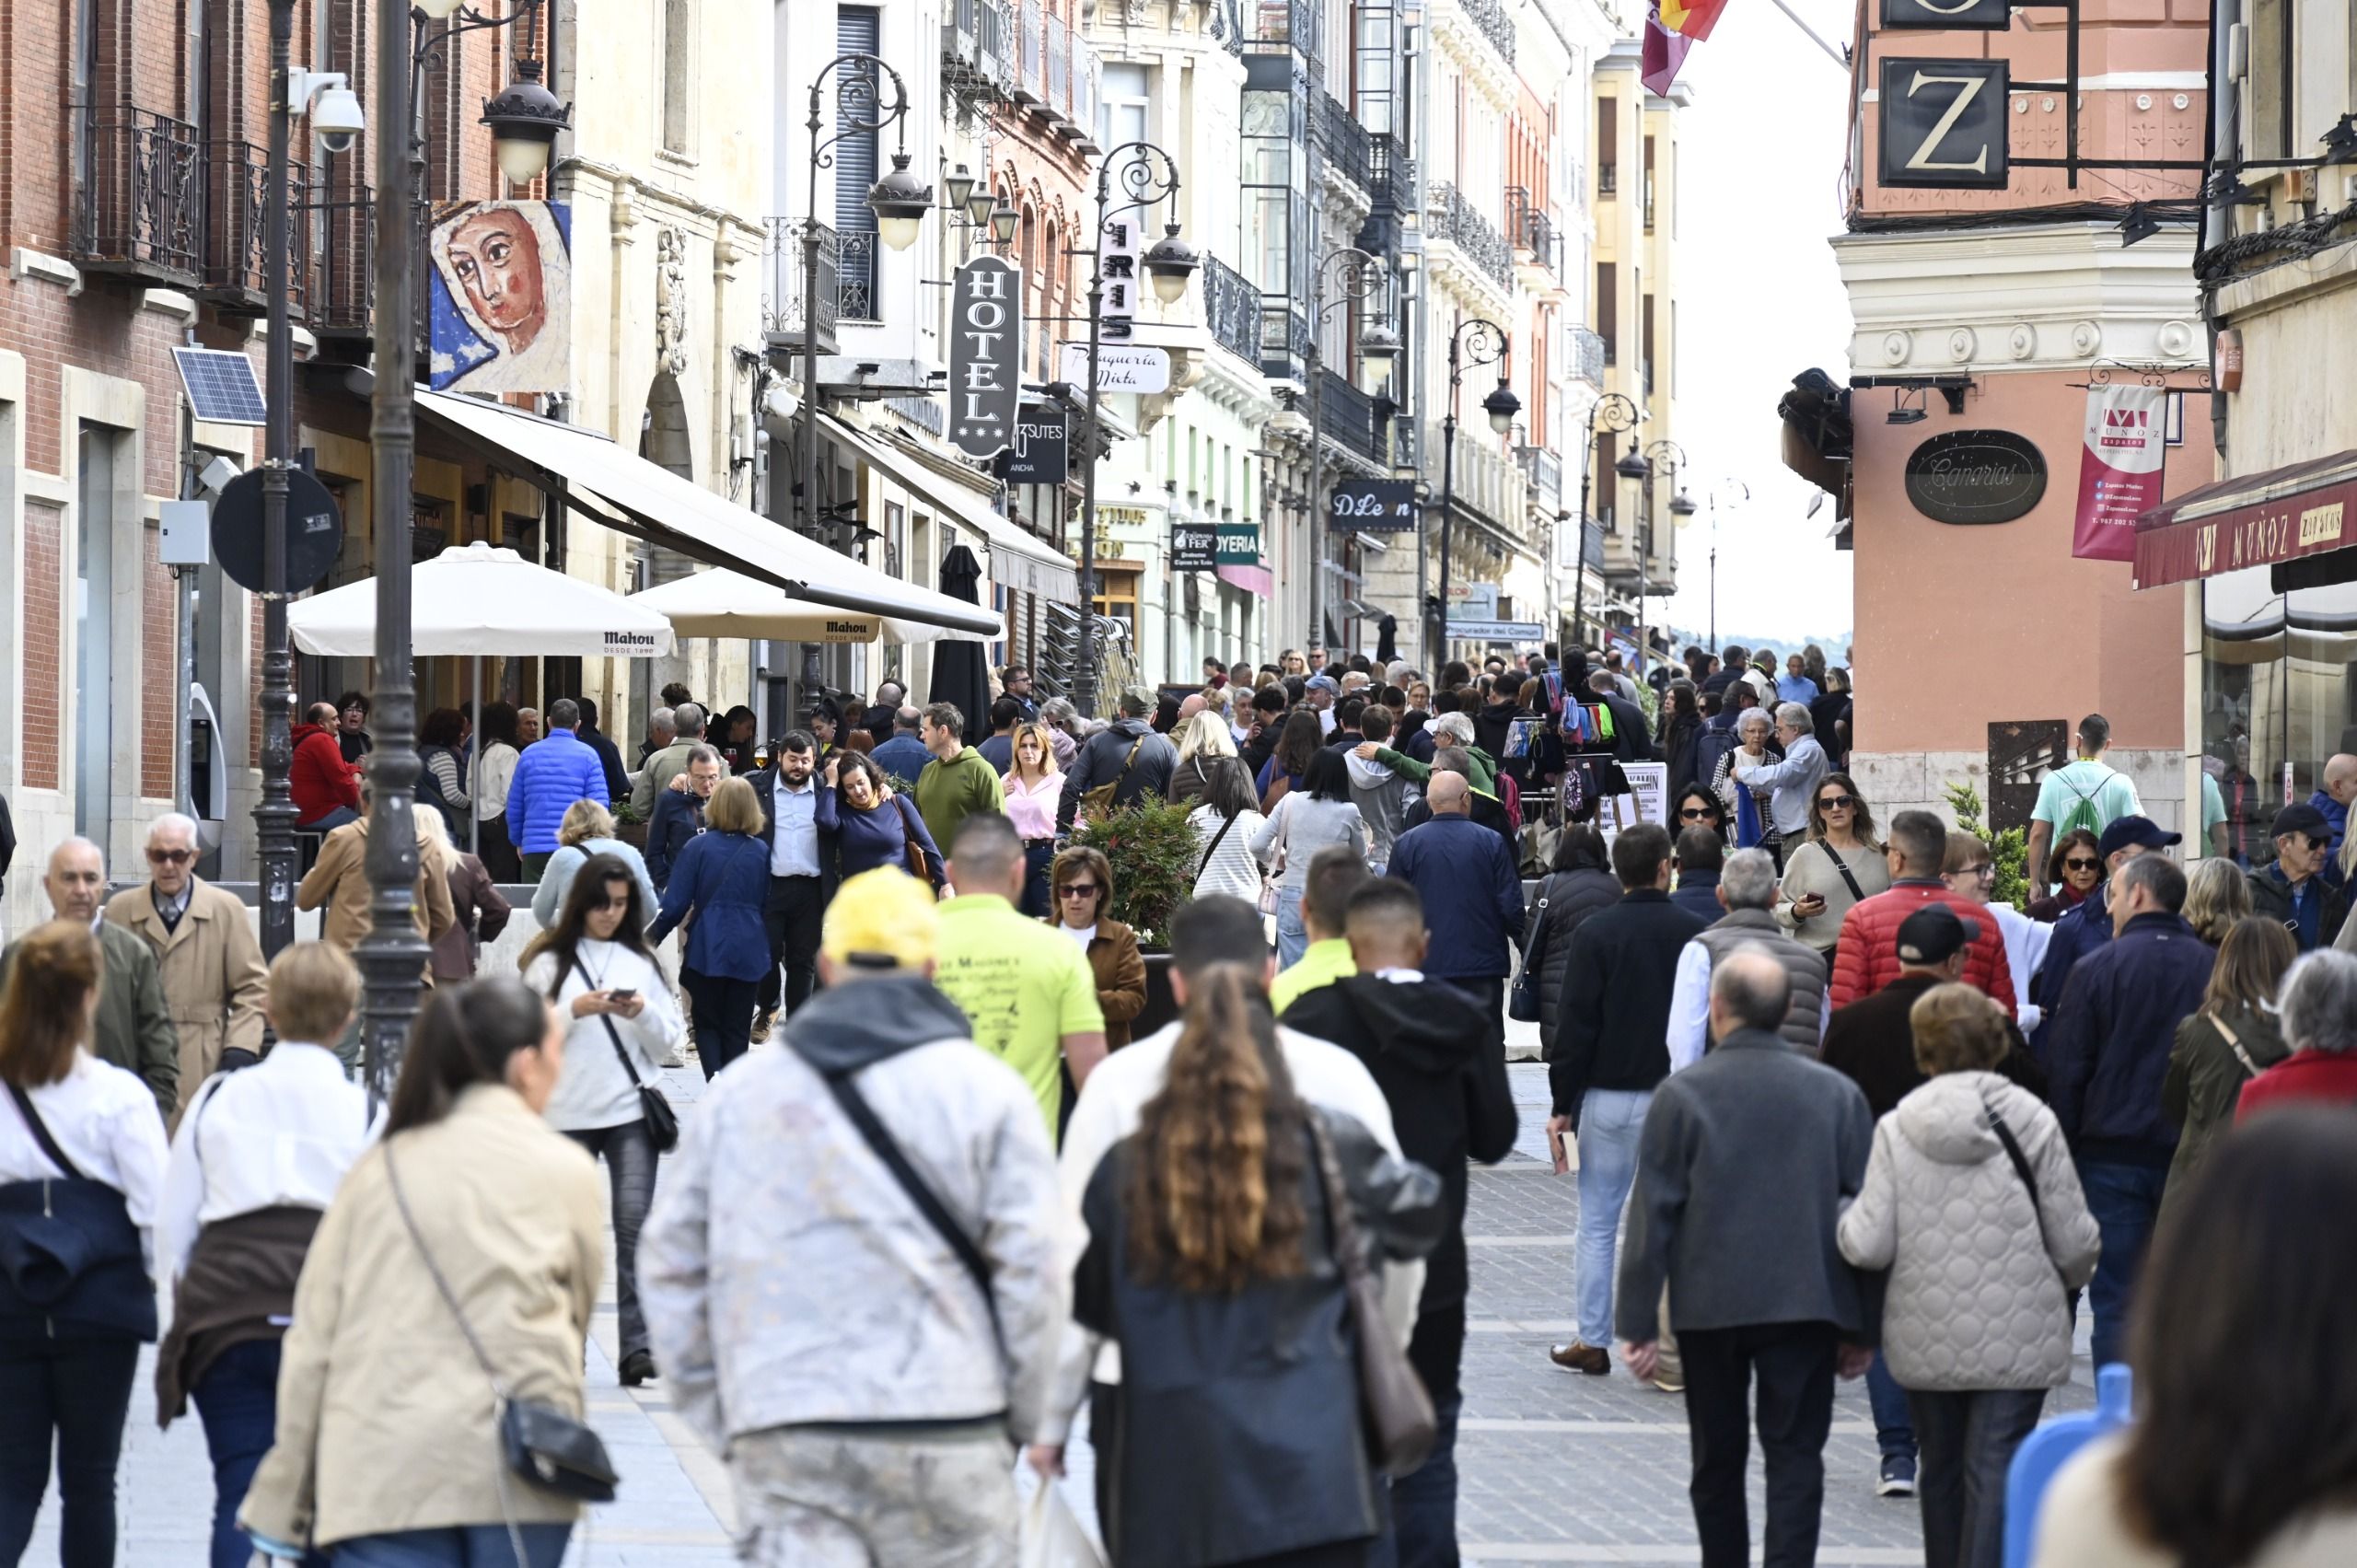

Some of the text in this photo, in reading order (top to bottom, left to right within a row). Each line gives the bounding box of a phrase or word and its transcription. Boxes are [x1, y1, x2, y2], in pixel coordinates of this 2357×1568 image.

[1102, 224, 1133, 339] IRIS
[964, 271, 1007, 422] HOTEL
[1072, 346, 1157, 368] Puquería
[2088, 427, 2160, 438] MUÑOZ
[1010, 463, 1035, 472] ANCHA
[1931, 459, 2015, 487] Canarias
[1189, 539, 1208, 549] FER
[2232, 510, 2288, 566] MUÑOZ
[826, 621, 868, 633] Mahou
[603, 631, 655, 645] Mahou
